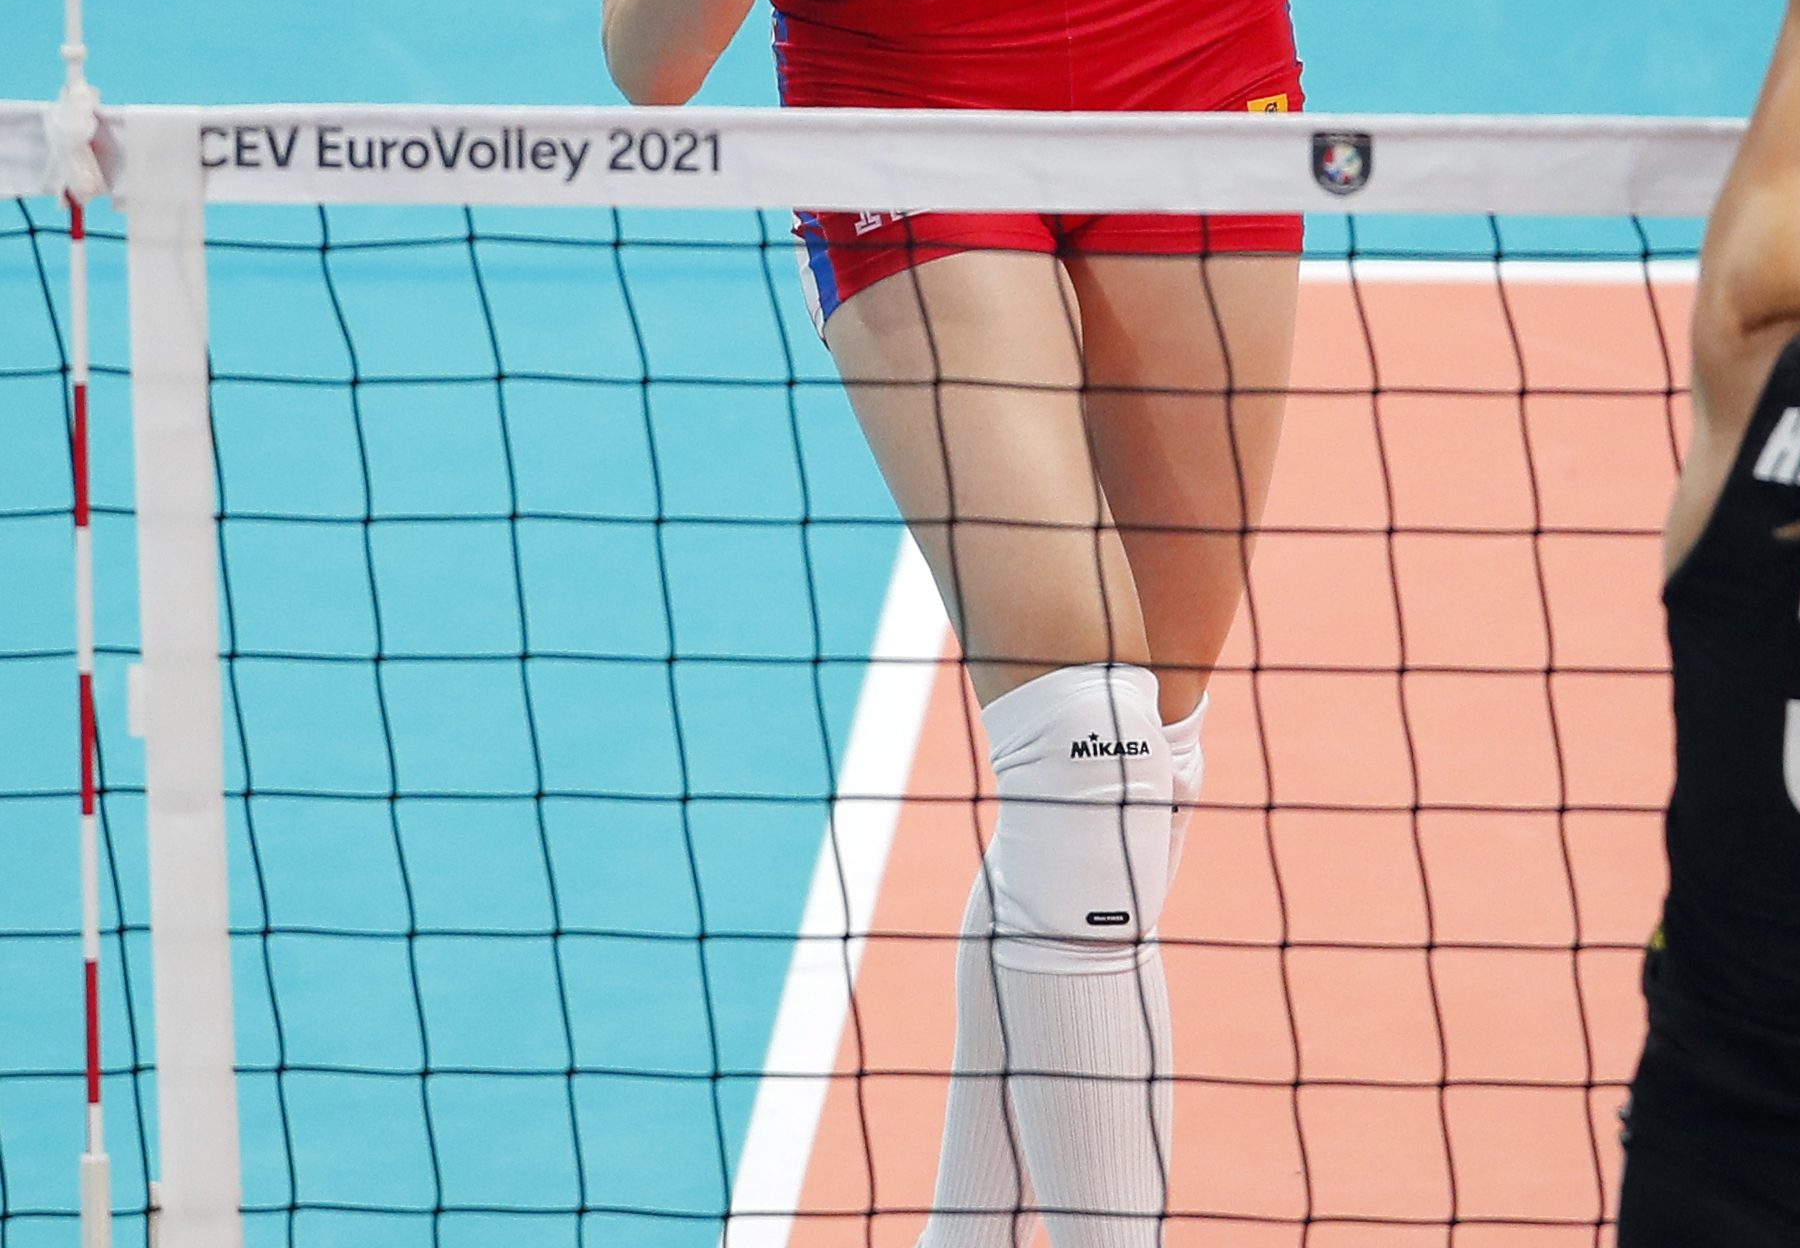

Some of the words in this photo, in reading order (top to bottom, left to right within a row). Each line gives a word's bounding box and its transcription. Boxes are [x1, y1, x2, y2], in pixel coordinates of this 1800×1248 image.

[200, 125, 298, 168] CEV
[317, 126, 590, 182] EuroVolley
[608, 128, 720, 172] 2021
